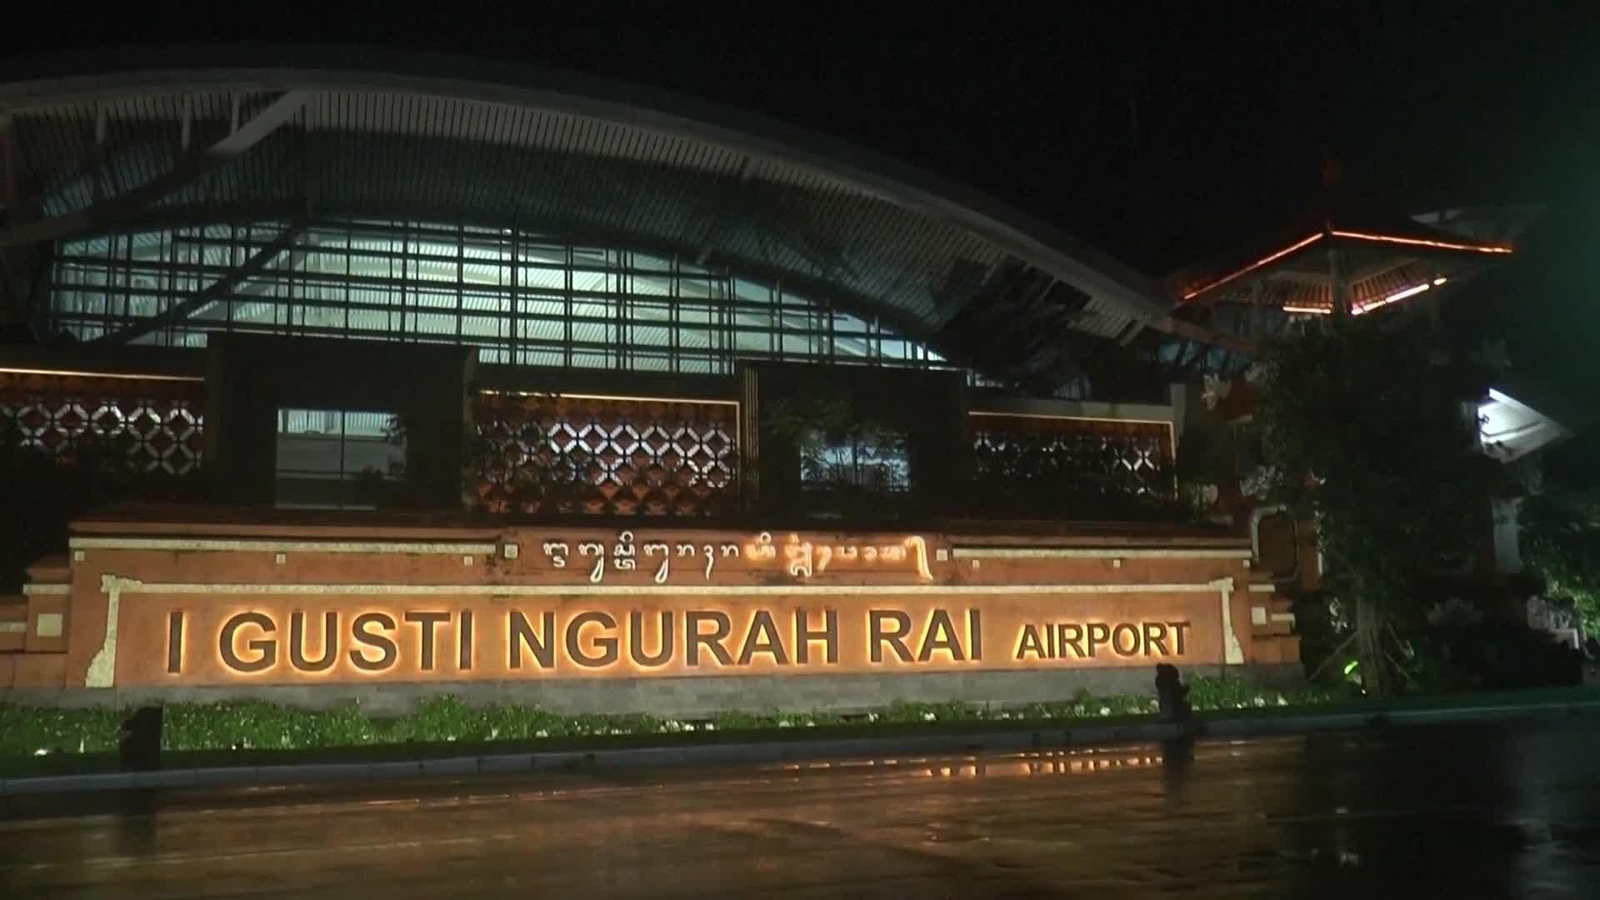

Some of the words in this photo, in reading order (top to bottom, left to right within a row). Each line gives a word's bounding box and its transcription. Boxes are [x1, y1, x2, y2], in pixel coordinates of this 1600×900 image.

[167, 611, 184, 674] I
[218, 610, 473, 674] GUSTI
[508, 609, 838, 669] NGURAH
[868, 607, 983, 664] RAI
[1015, 621, 1191, 661] AIRPORT
